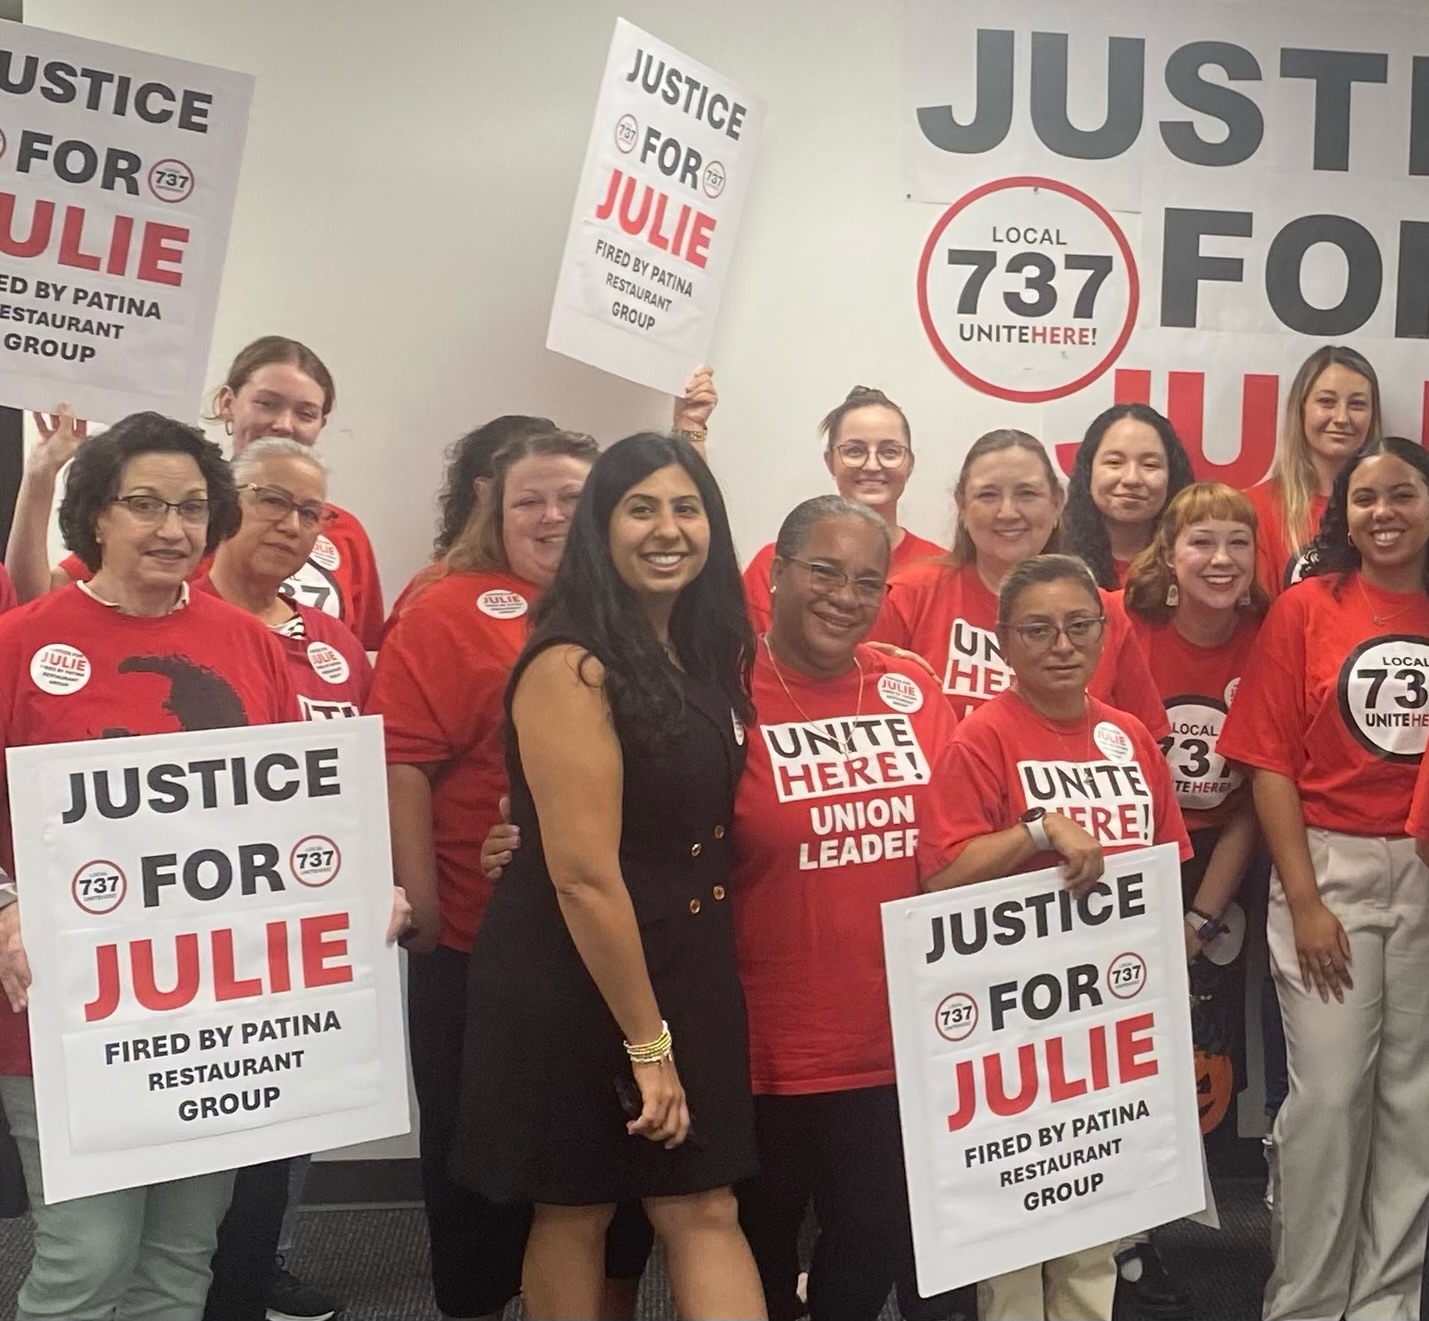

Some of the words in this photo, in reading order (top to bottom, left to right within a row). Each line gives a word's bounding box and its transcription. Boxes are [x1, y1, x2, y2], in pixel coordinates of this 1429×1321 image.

[0, 50, 213, 134] USTICE
[626, 48, 748, 141] JUSTICE
[619, 124, 637, 142] 737
[16, 129, 142, 196] FOR
[640, 125, 702, 190] FOR
[155, 170, 190, 190] 737
[706, 169, 724, 187] 737
[595, 168, 717, 269] JULIE
[992, 226, 1068, 246] LOCAL
[0, 192, 190, 287] ULIE
[595, 239, 631, 269] FIRED
[633, 257, 650, 277] BY
[650, 263, 693, 298] PATINA
[947, 249, 1113, 320] 737
[35, 280, 68, 301] BY
[72, 287, 162, 320] PATINA
[606, 273, 673, 312] RESTAURANT
[0, 304, 125, 339] ESTAURANT
[611, 301, 656, 331] GROUP
[4, 332, 96, 363] GROUP
[484, 596, 521, 604] JULIE
[41, 652, 86, 672] JULIE
[881, 679, 916, 696] JULIE
[767, 717, 914, 760] UNITE
[1172, 722, 1219, 737] LOCAL
[61, 747, 341, 824] JUSTICE
[779, 750, 924, 797] HERE!
[1024, 764, 1149, 801] UNITE
[810, 796, 915, 837] UNION
[1056, 804, 1149, 841] ERE!
[140, 842, 286, 908] FOR
[296, 851, 334, 870] 737
[79, 875, 120, 895] 737
[925, 872, 1146, 964] JUSTICE
[84, 911, 353, 1022] JULIE
[1111, 965, 1141, 985] 737
[940, 1005, 973, 1026] 737
[989, 963, 1104, 1032] FOR
[104, 1032, 191, 1065] FIRED
[199, 1025, 233, 1052] BY
[242, 1010, 341, 1044] PATINA
[148, 1050, 304, 1092] RESTAURANT
[947, 1012, 1159, 1132] JULIE
[178, 1086, 281, 1122] GROUP
[964, 1133, 1032, 1168] FIRED
[1038, 1122, 1067, 1148] BY
[1072, 1099, 1150, 1137] PATINA
[999, 1138, 1122, 1187] RESTAURANT
[1023, 1172, 1104, 1212] GROUP
